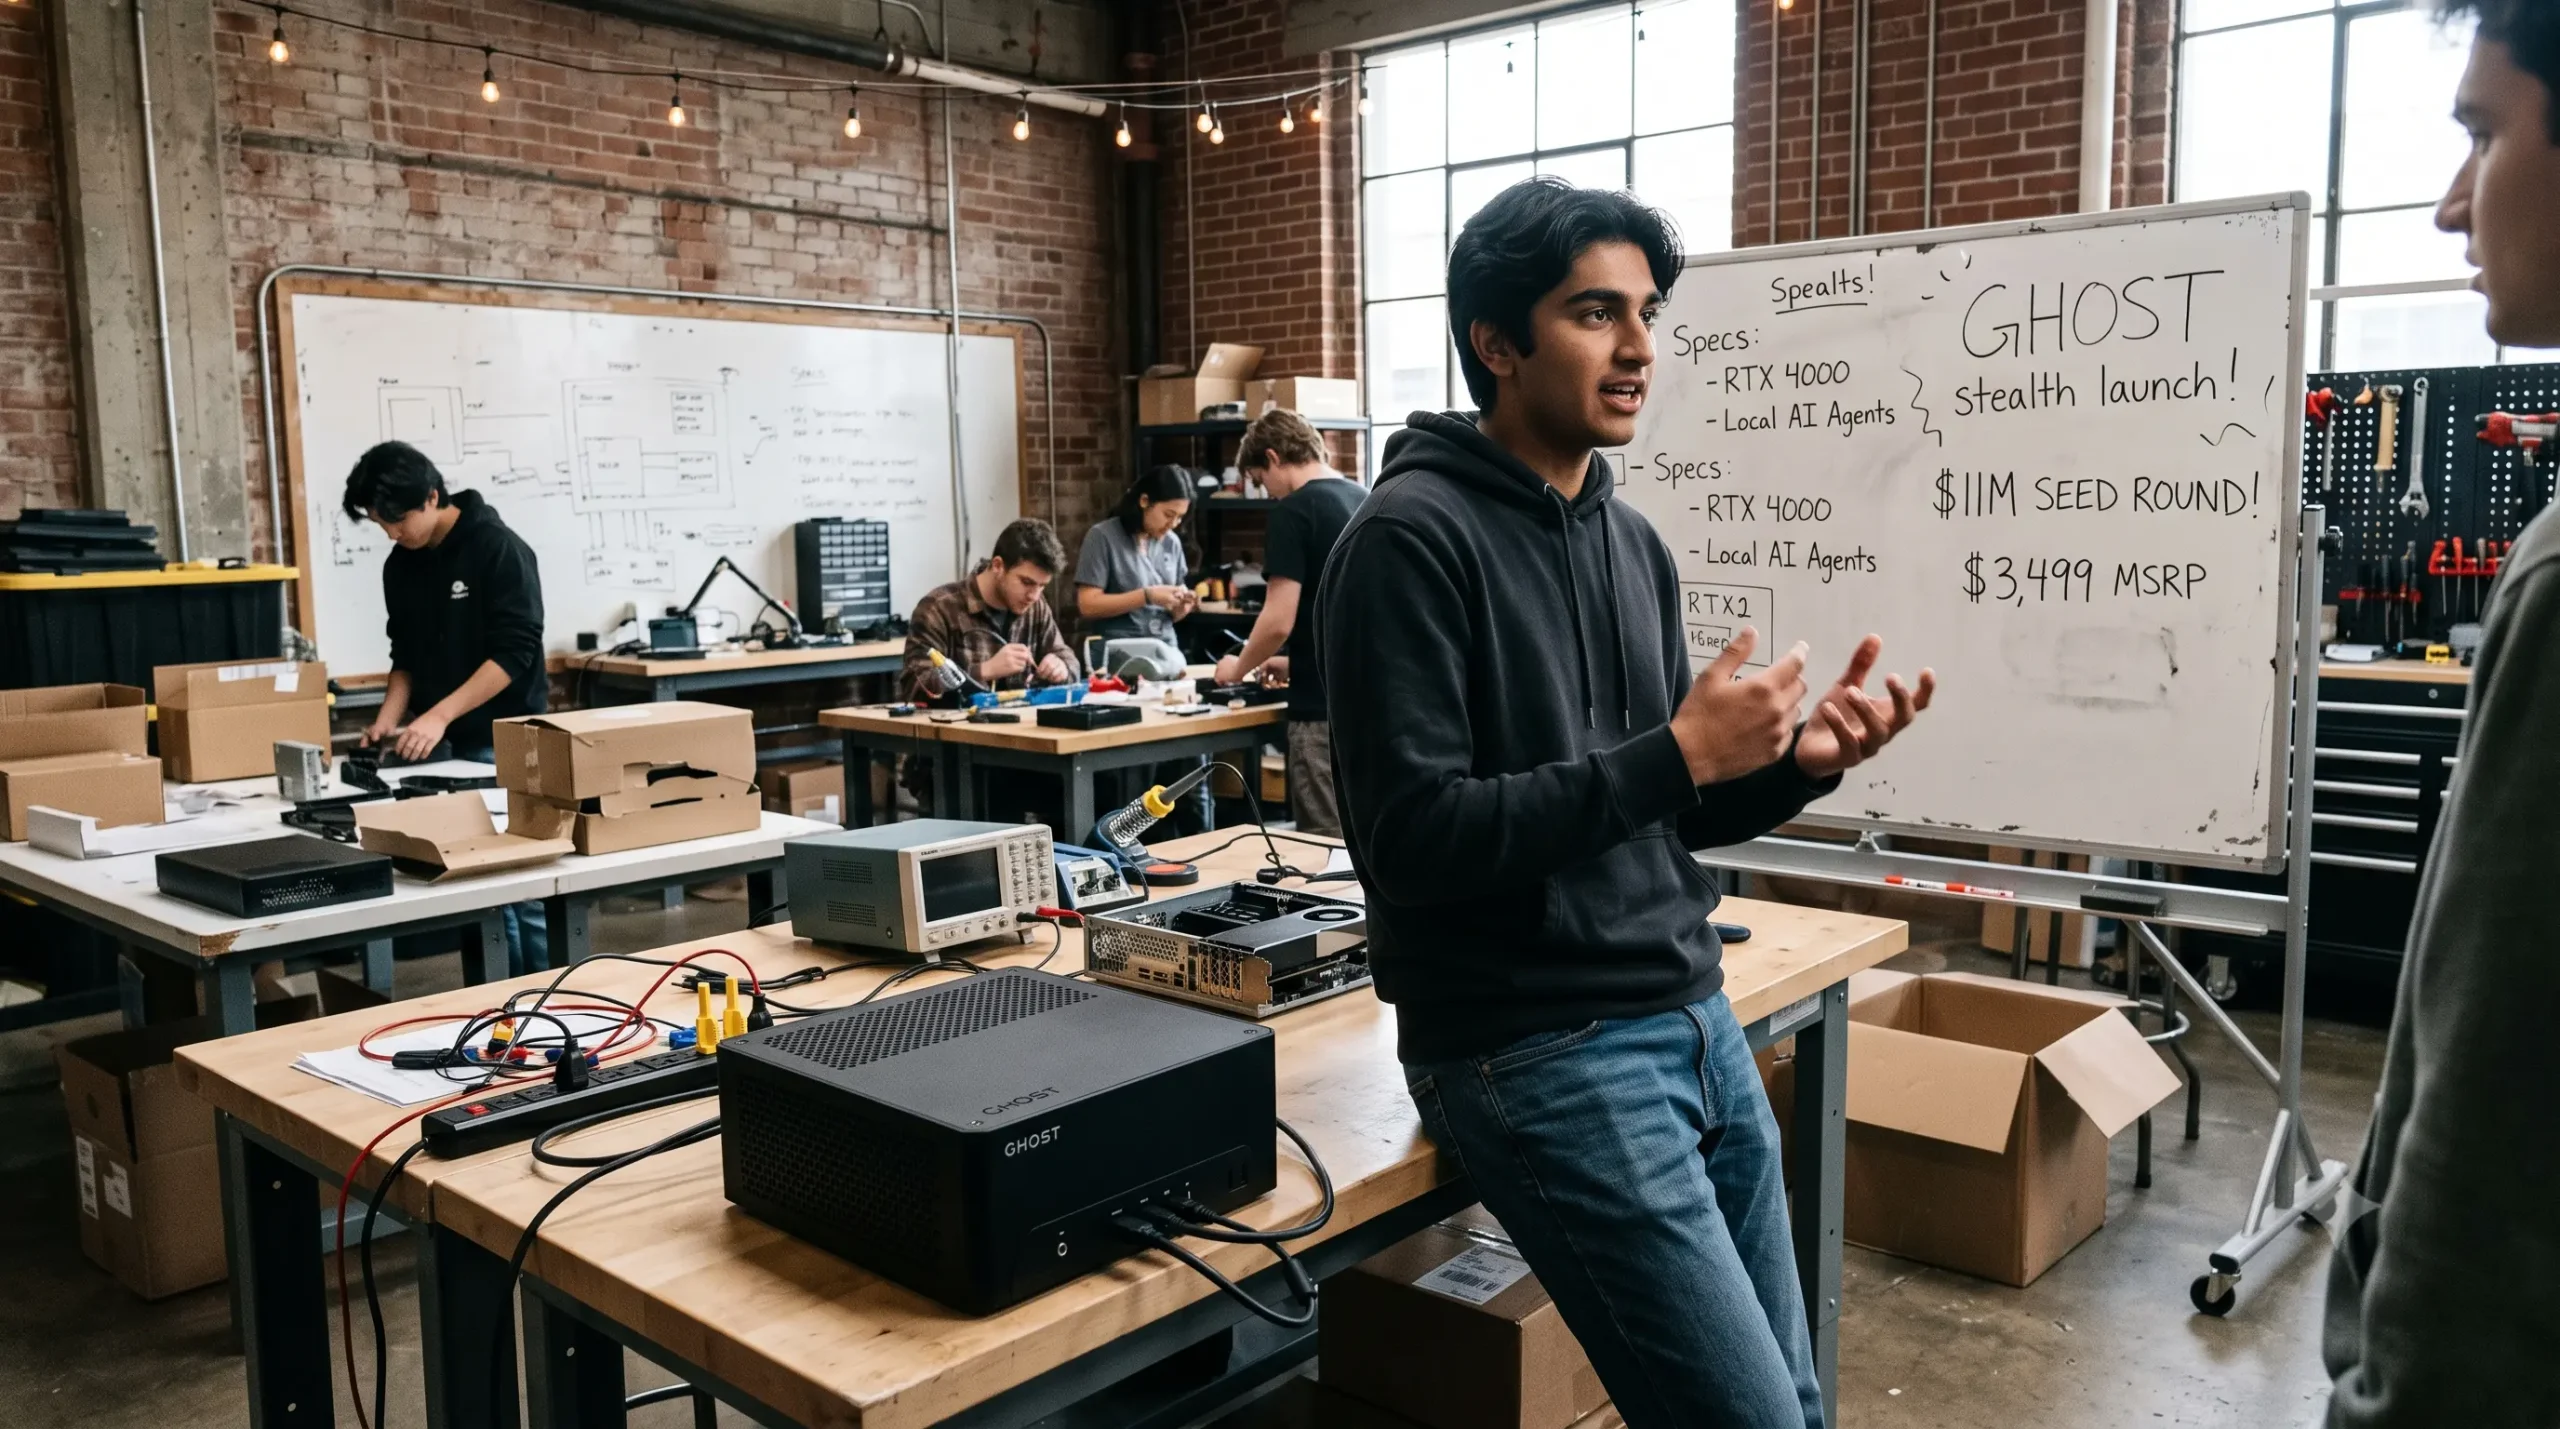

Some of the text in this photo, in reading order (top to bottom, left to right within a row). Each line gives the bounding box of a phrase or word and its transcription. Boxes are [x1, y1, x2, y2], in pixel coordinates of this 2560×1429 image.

[1771, 263, 1874, 309] Spealts!
[1962, 269, 2225, 358] GHOST
[1673, 324, 1759, 365] Specs:
[1785, 360, 1851, 389] 4000
[1954, 346, 2238, 417] stealth launch!
[1788, 402, 1818, 429] AI
[1826, 398, 1896, 438] Agents
[1654, 452, 1731, 490] Specs:
[1766, 494, 1832, 523] 4000
[1932, 467, 2259, 521] $11M SEED ROUND!
[1768, 540, 1797, 568] AI
[1807, 541, 1877, 585] Agents
[1962, 550, 2207, 608] $3,499 MSRP
[982, 1086, 1060, 1115] GHOST
[1004, 1125, 1061, 1157] GHOST
